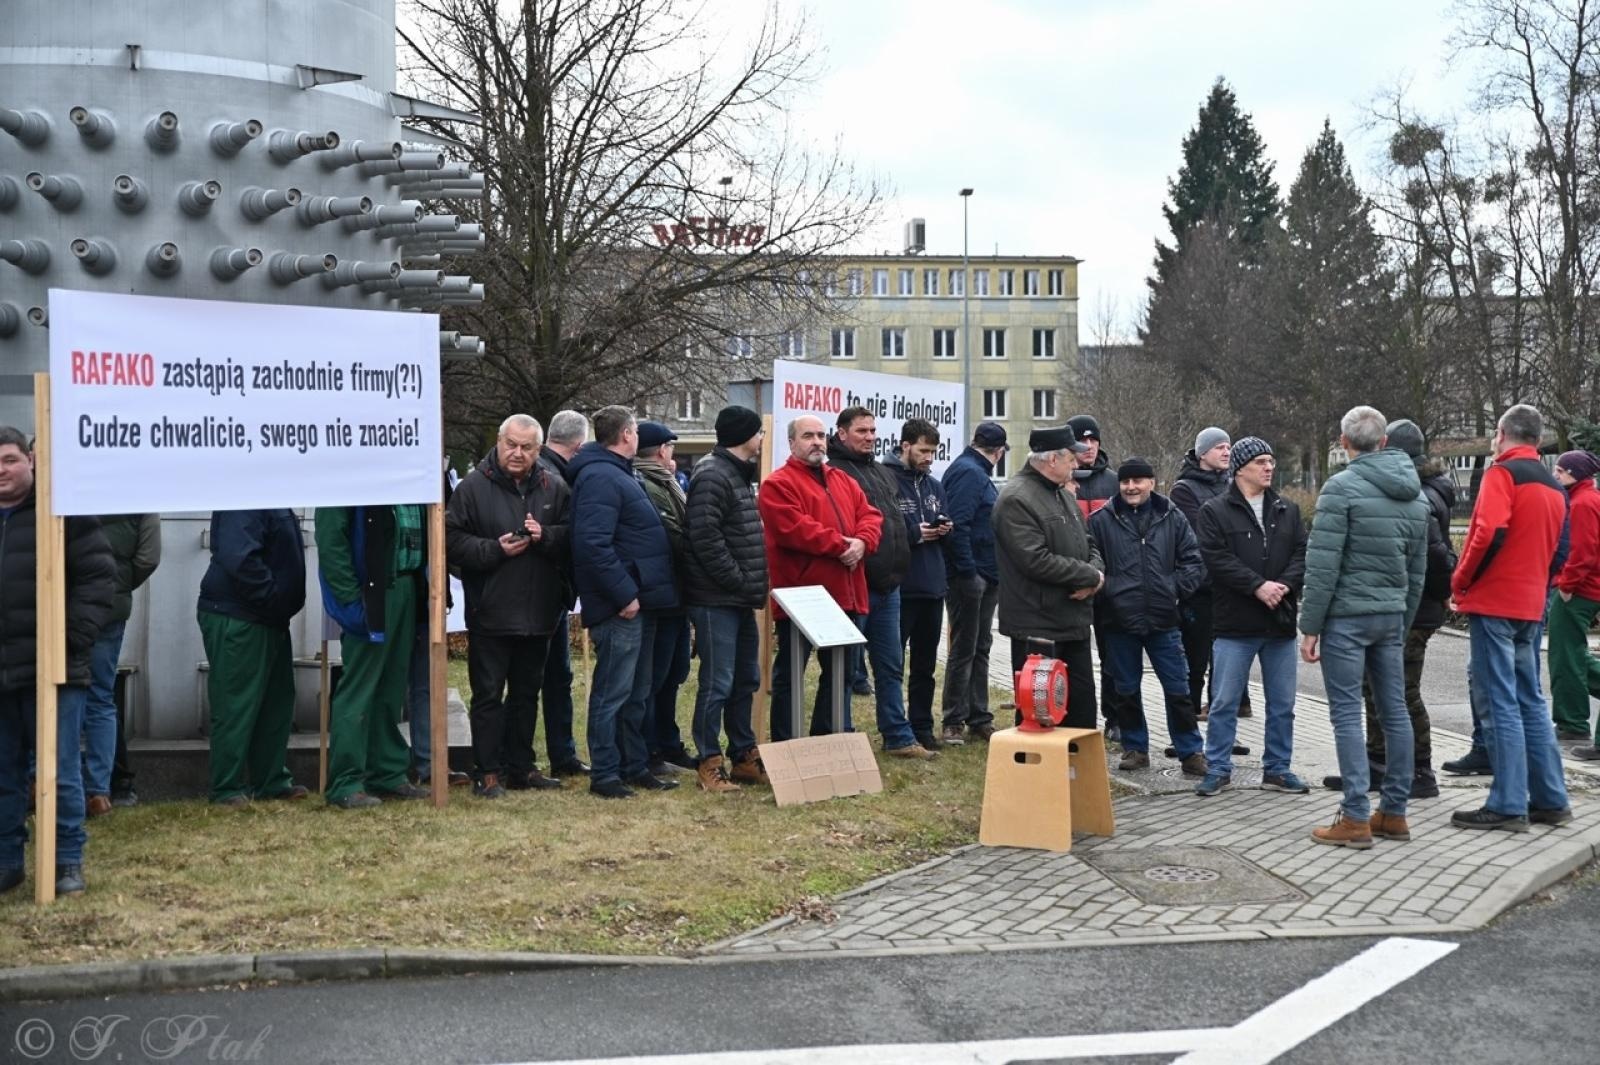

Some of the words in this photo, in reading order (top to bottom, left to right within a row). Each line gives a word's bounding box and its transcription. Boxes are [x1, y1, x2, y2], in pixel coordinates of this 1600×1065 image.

[71, 351, 154, 387] RAFAKO
[162, 357, 246, 397] zastąpią
[251, 359, 344, 392] zachodnie
[350, 361, 423, 400] firmy(?!)
[784, 381, 842, 414] RAFAKO
[866, 392, 888, 419] nie
[892, 394, 957, 427] ideologia!
[78, 413, 141, 449] Cudze
[150, 415, 253, 454] chwalicie,
[259, 423, 319, 455] swego
[325, 416, 353, 448] nie
[358, 417, 420, 448] znacie!
